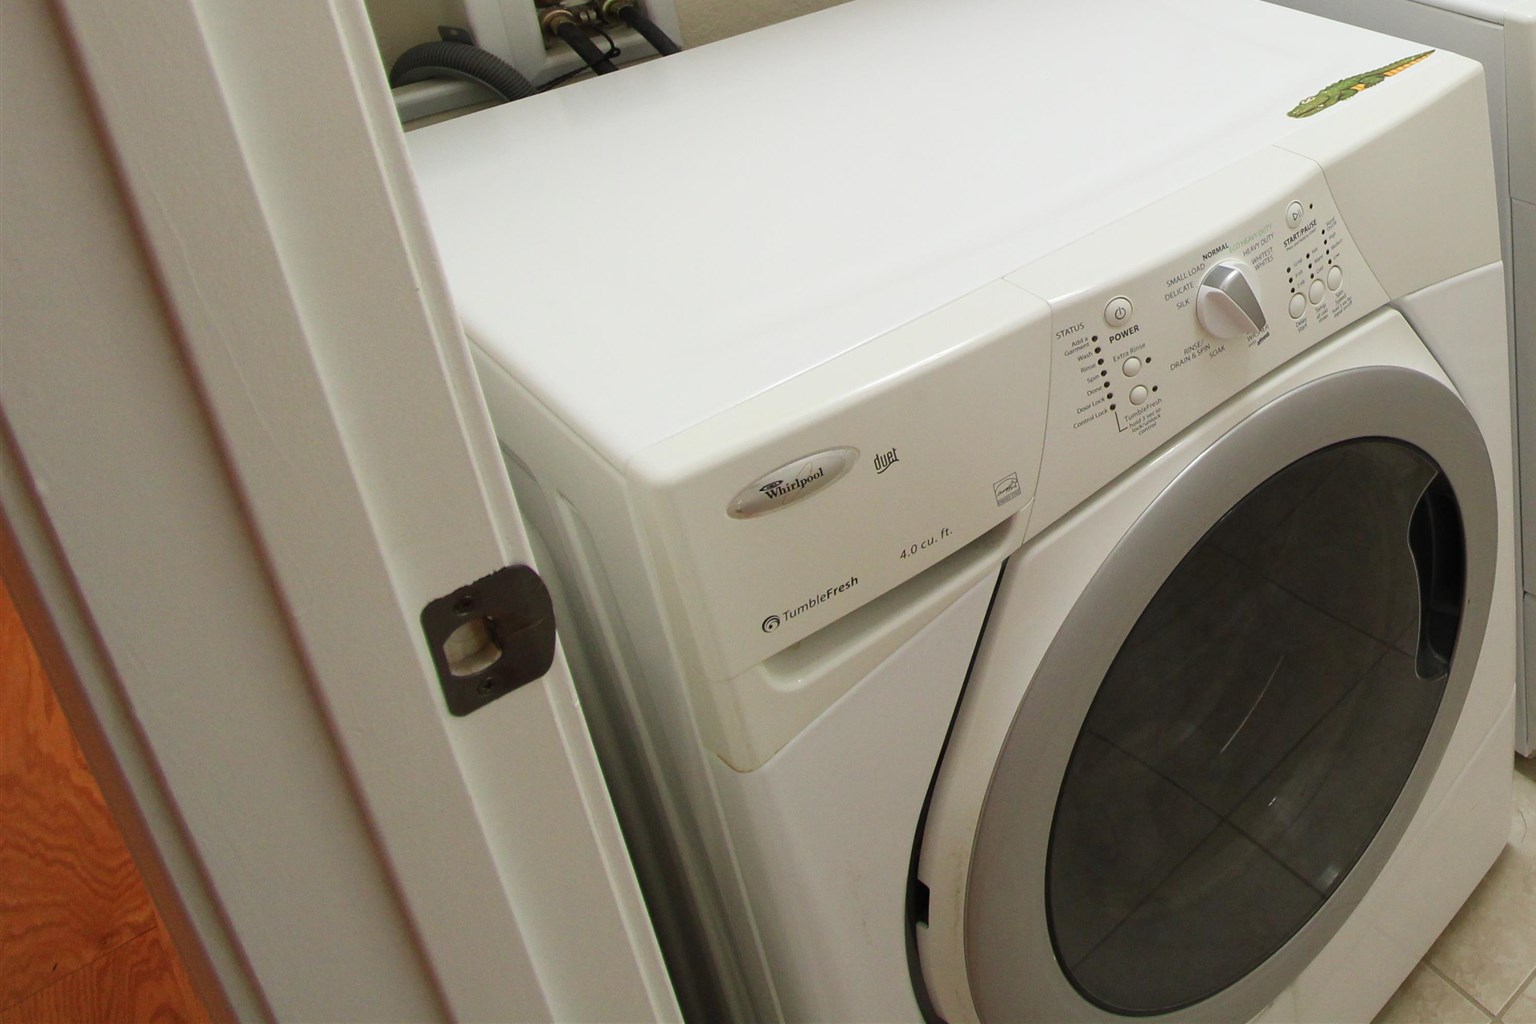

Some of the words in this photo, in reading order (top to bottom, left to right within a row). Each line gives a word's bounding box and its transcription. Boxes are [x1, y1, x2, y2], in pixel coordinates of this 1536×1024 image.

[1283, 218, 1318, 248] START/PAUSE
[1201, 242, 1230, 261] NORMAL
[1242, 240, 1261, 257] HEAVY
[1260, 232, 1275, 247] DUTY
[1250, 246, 1273, 265] WHITEST
[1254, 256, 1275, 271] WHITES
[1166, 272, 1188, 288] SMALL
[1188, 262, 1206, 277] LOAD
[1164, 281, 1196, 302] DELICATE
[1175, 298, 1191, 311] SILK
[1055, 322, 1085, 340] STATUS
[1108, 324, 1140, 344] POWER
[1064, 341, 1090, 357] Garment
[1071, 338, 1084, 348] Add
[1112, 351, 1130, 363] Extra
[1129, 342, 1147, 354] Rinse
[1209, 345, 1226, 360] SOAK
[1077, 351, 1094, 362] Wash
[1170, 355, 1192, 372] DRAIN
[1196, 343, 1211, 358] SPIN
[1080, 363, 1097, 374] Rinse
[1086, 374, 1100, 385] Spin
[1086, 386, 1103, 397] Done
[1076, 403, 1092, 415] Door
[1091, 396, 1106, 408] Lock
[1124, 397, 1163, 423] TumbleFresh
[1072, 414, 1095, 430] Control
[1094, 408, 1108, 419] Lock
[873, 447, 900, 475] duet
[764, 467, 825, 500] Whirlpool
[899, 544, 918, 560] 4.0
[920, 535, 938, 550] cu.
[940, 527, 954, 539] ft.
[782, 576, 859, 622] TumbleFresh
